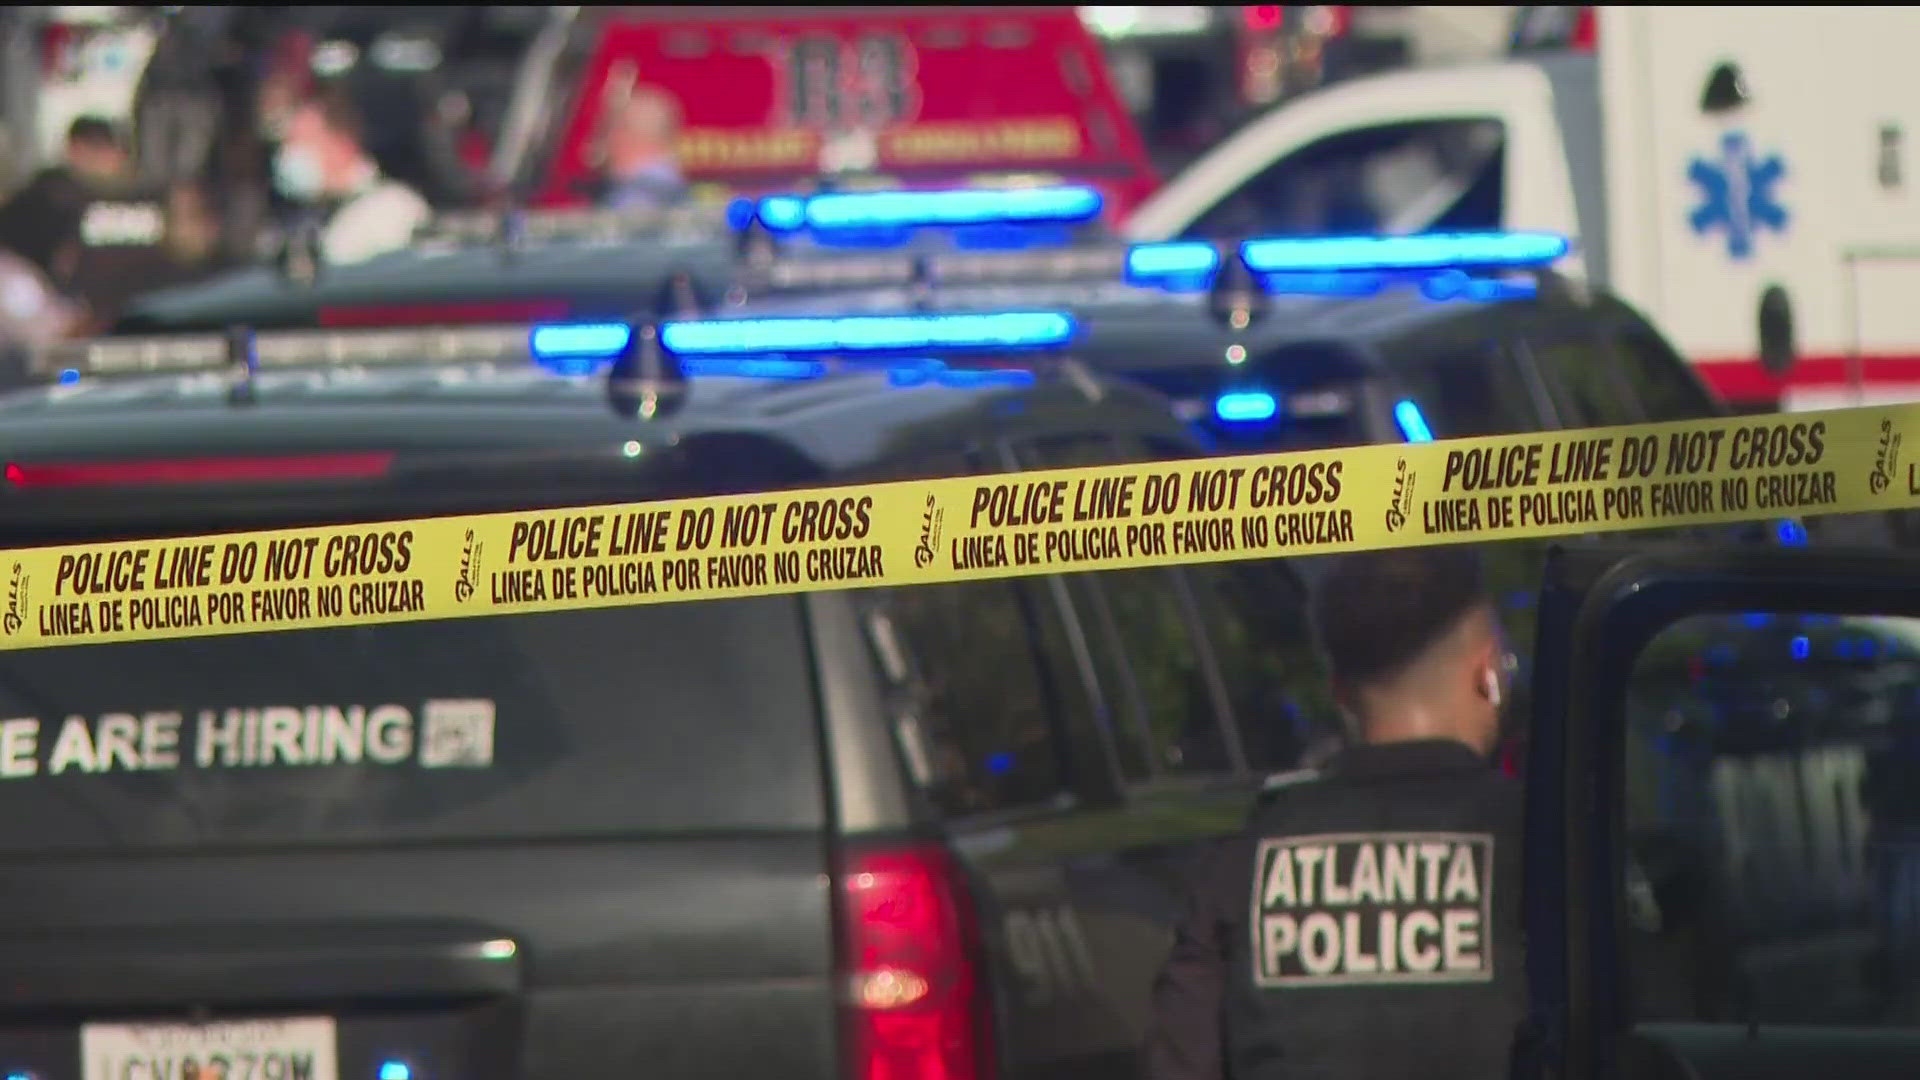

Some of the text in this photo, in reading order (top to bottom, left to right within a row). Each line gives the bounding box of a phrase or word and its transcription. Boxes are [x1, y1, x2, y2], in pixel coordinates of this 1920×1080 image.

[1442, 421, 1825, 492] POLICE LINE DO NOT CROSS
[971, 461, 1342, 528] POLICE LINE DO NOT CROSS
[1423, 472, 1836, 534] LINEA DE POLICIA POR FAVOR NO CRUZAR
[509, 496, 872, 563] POLICE LINE DO NOT CROSS
[952, 510, 1354, 570] LINEA DE POLICIA POR FAVOR NO CRUZAR
[56, 531, 413, 596] POLICE LINE DO NOT CROSS
[492, 545, 883, 604] LINEA DE POLICIA POR FAVOR NO CRUZAR
[40, 580, 424, 636] LINEA DE POLICIA POR FAVOR NO CRUZAR
[0, 704, 414, 779] E ARE HIRING
[1264, 843, 1478, 907] ATLANTA
[1264, 911, 1481, 976] POLICE
